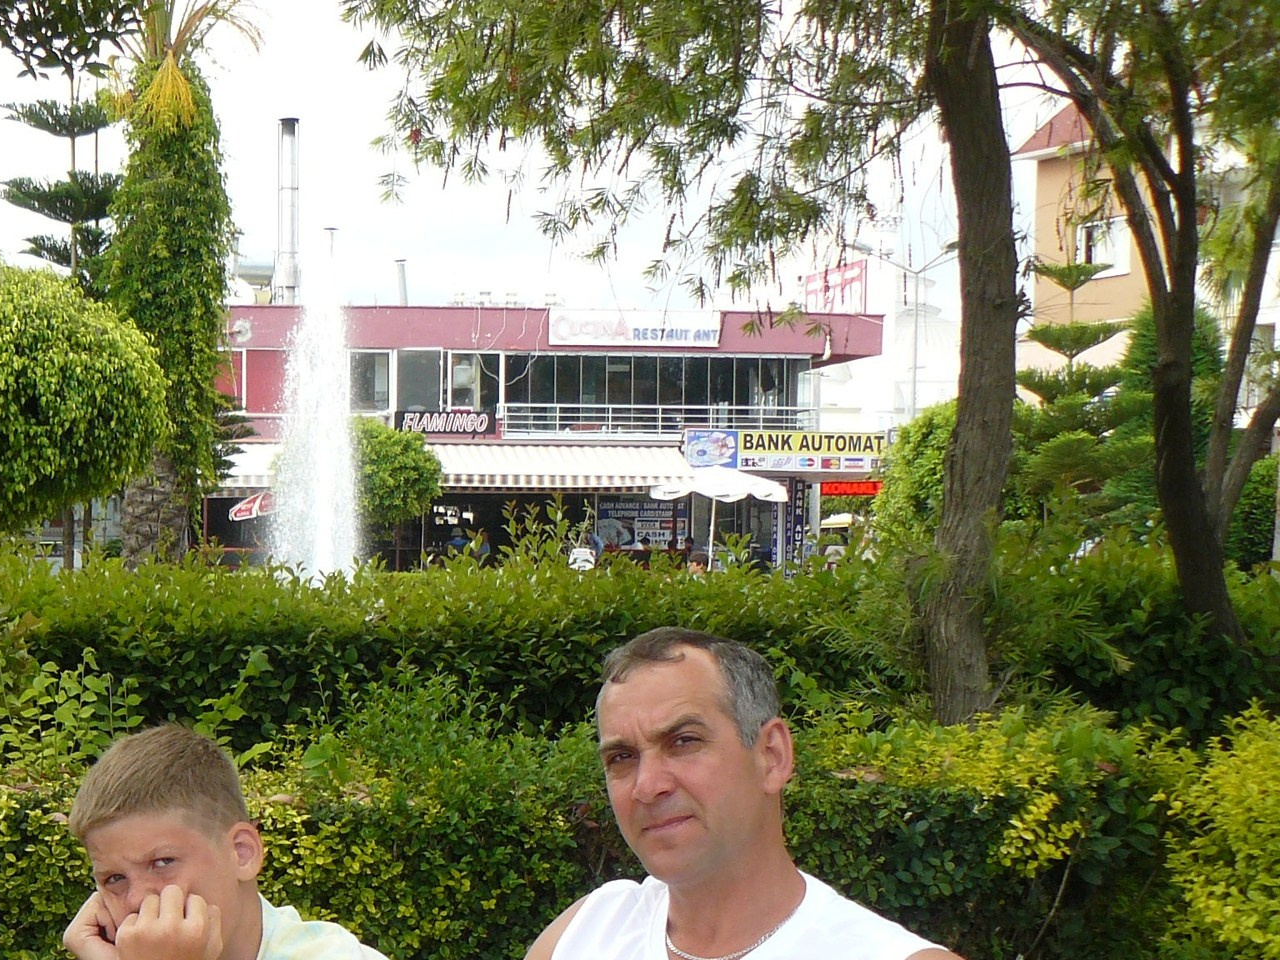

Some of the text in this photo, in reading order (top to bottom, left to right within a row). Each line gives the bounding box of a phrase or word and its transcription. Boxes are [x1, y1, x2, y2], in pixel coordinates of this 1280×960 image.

[403, 412, 489, 433] FLAMINGO
[743, 433, 885, 452] BANK AUTOMAT
